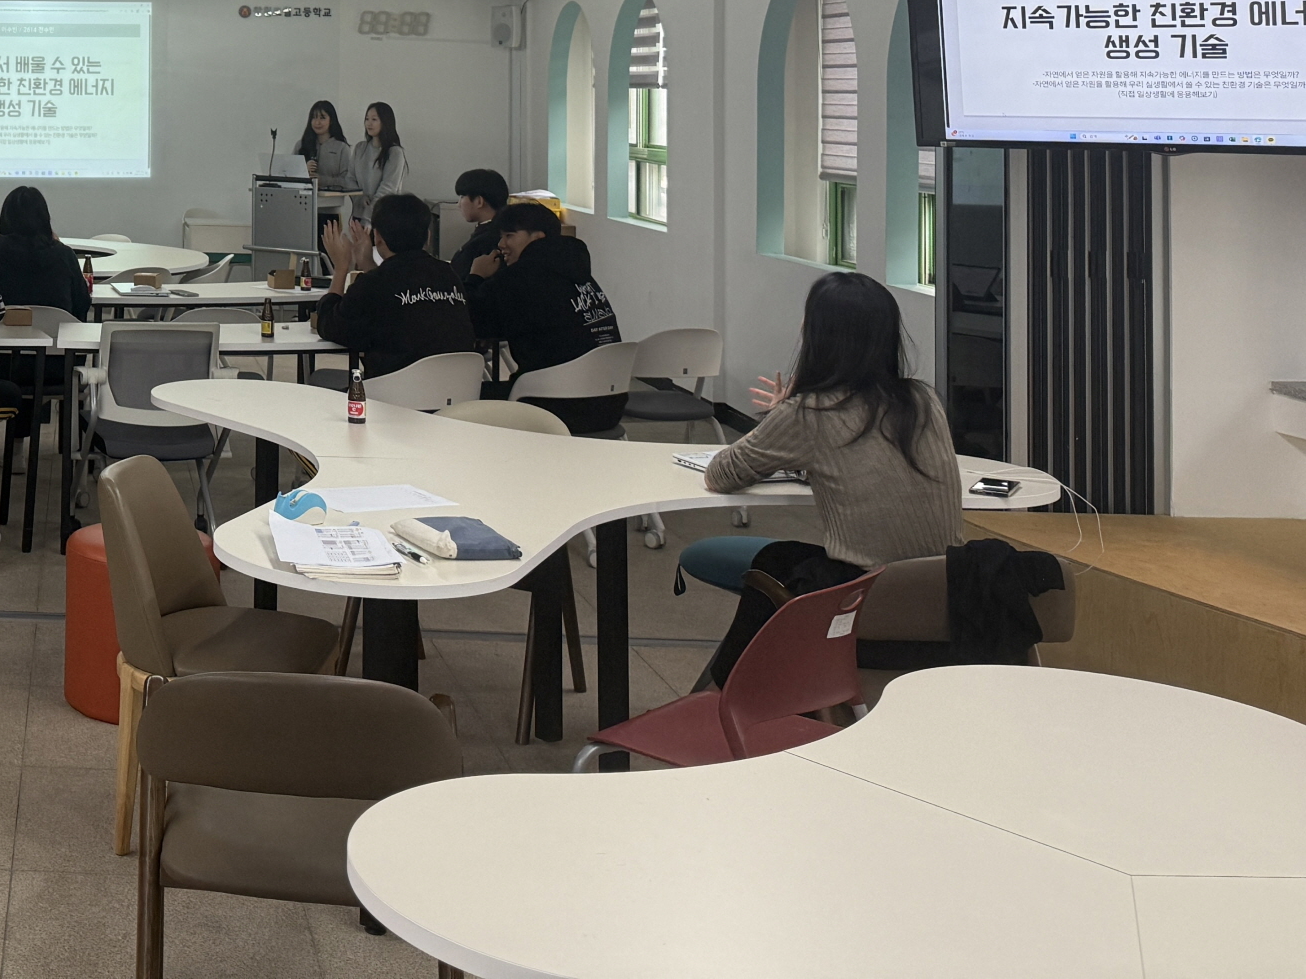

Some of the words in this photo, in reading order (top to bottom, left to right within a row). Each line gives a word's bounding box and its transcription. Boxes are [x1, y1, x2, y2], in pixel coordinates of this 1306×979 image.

[253, 6, 332, 18] 고등학교
[1001, 2, 1141, 31] 지속가능한
[1149, 1, 1239, 29] 친환경
[1104, 34, 1160, 60] 생성
[1171, 33, 1229, 60] 기술
[15, 56, 46, 74] 배울
[50, 56, 66, 74] 수
[71, 56, 102, 75] 있는
[17, 78, 63, 96] 친환경
[69, 78, 115, 96] 에너지
[27, 100, 57, 118] 기술
